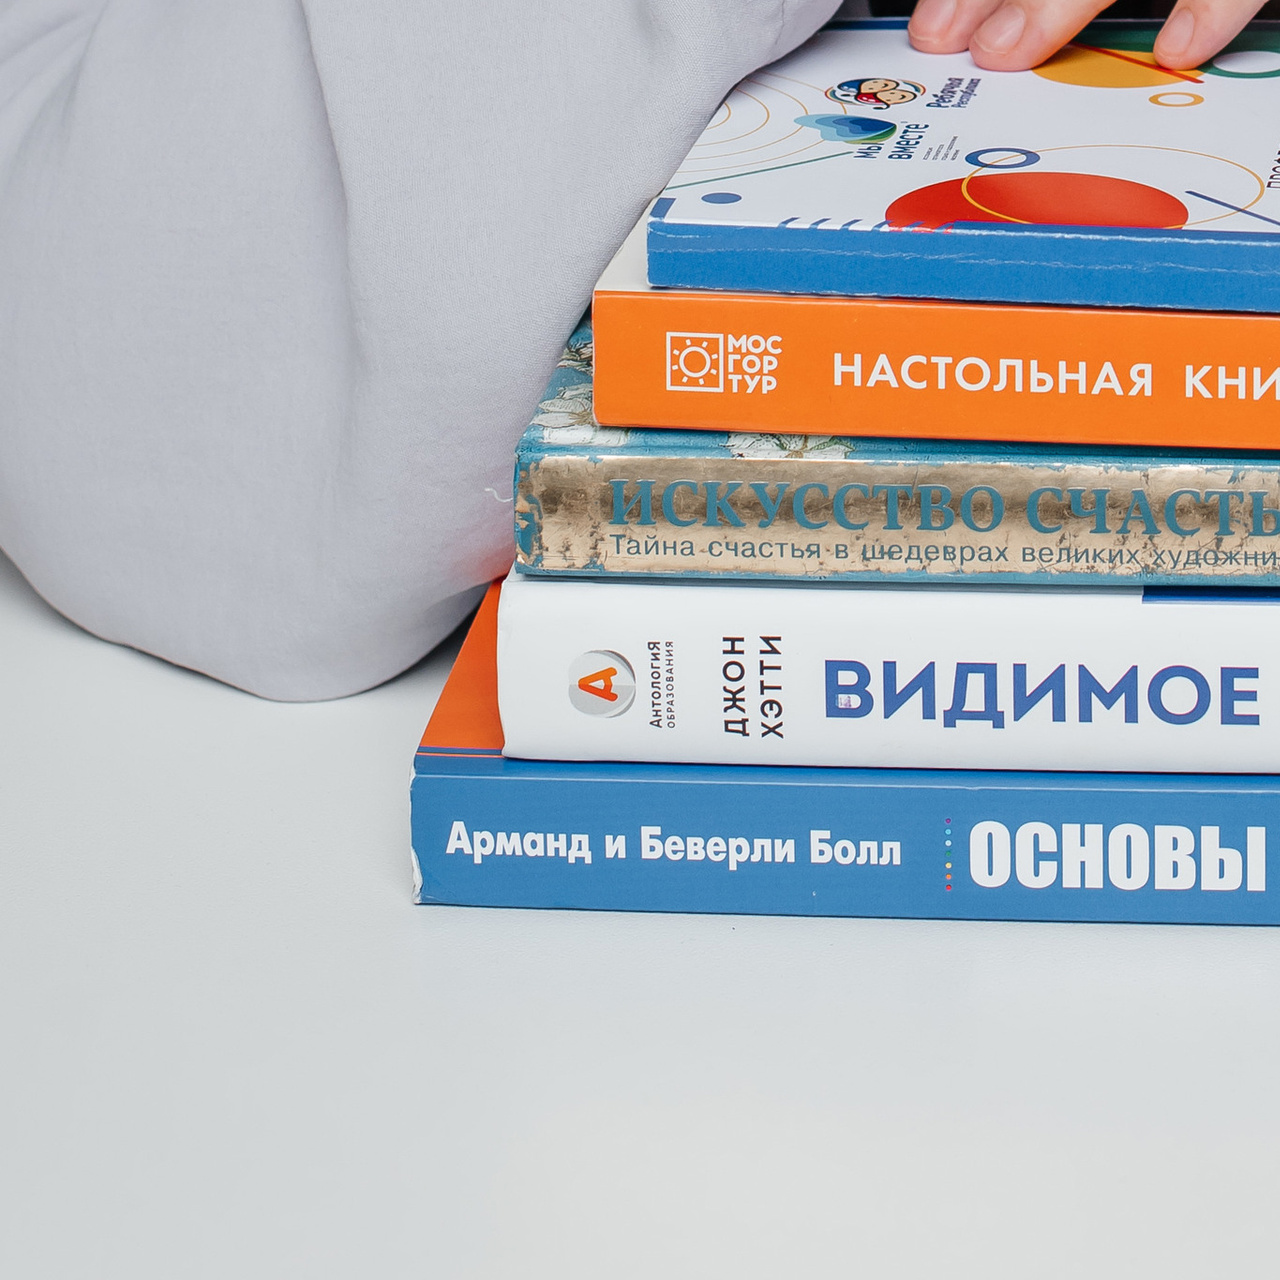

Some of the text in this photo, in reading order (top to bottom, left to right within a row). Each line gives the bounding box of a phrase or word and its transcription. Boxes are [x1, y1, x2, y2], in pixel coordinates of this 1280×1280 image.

[728, 334, 783, 355] МОС
[728, 354, 780, 375] ГОР
[728, 374, 778, 395] ТУР
[833, 352, 1153, 397] НАСТОЛЬНАЯ
[607, 478, 1005, 533] ИСКУССТВО
[609, 533, 696, 557] Тайна
[708, 539, 822, 560] счастья
[834, 543, 850, 560] в
[861, 541, 1008, 566] шедеврах
[1021, 544, 1146, 567] великих
[665, 640, 676, 729] ОБРАЗОВАНИЯ
[722, 636, 750, 737] ДЖОН
[759, 635, 784, 739] ХЭТТИ
[824, 659, 1261, 729] ВИДИМОЕ
[446, 820, 902, 871] Арманд и Беверли Болл
[968, 820, 1267, 892] ОСНОВЫ
